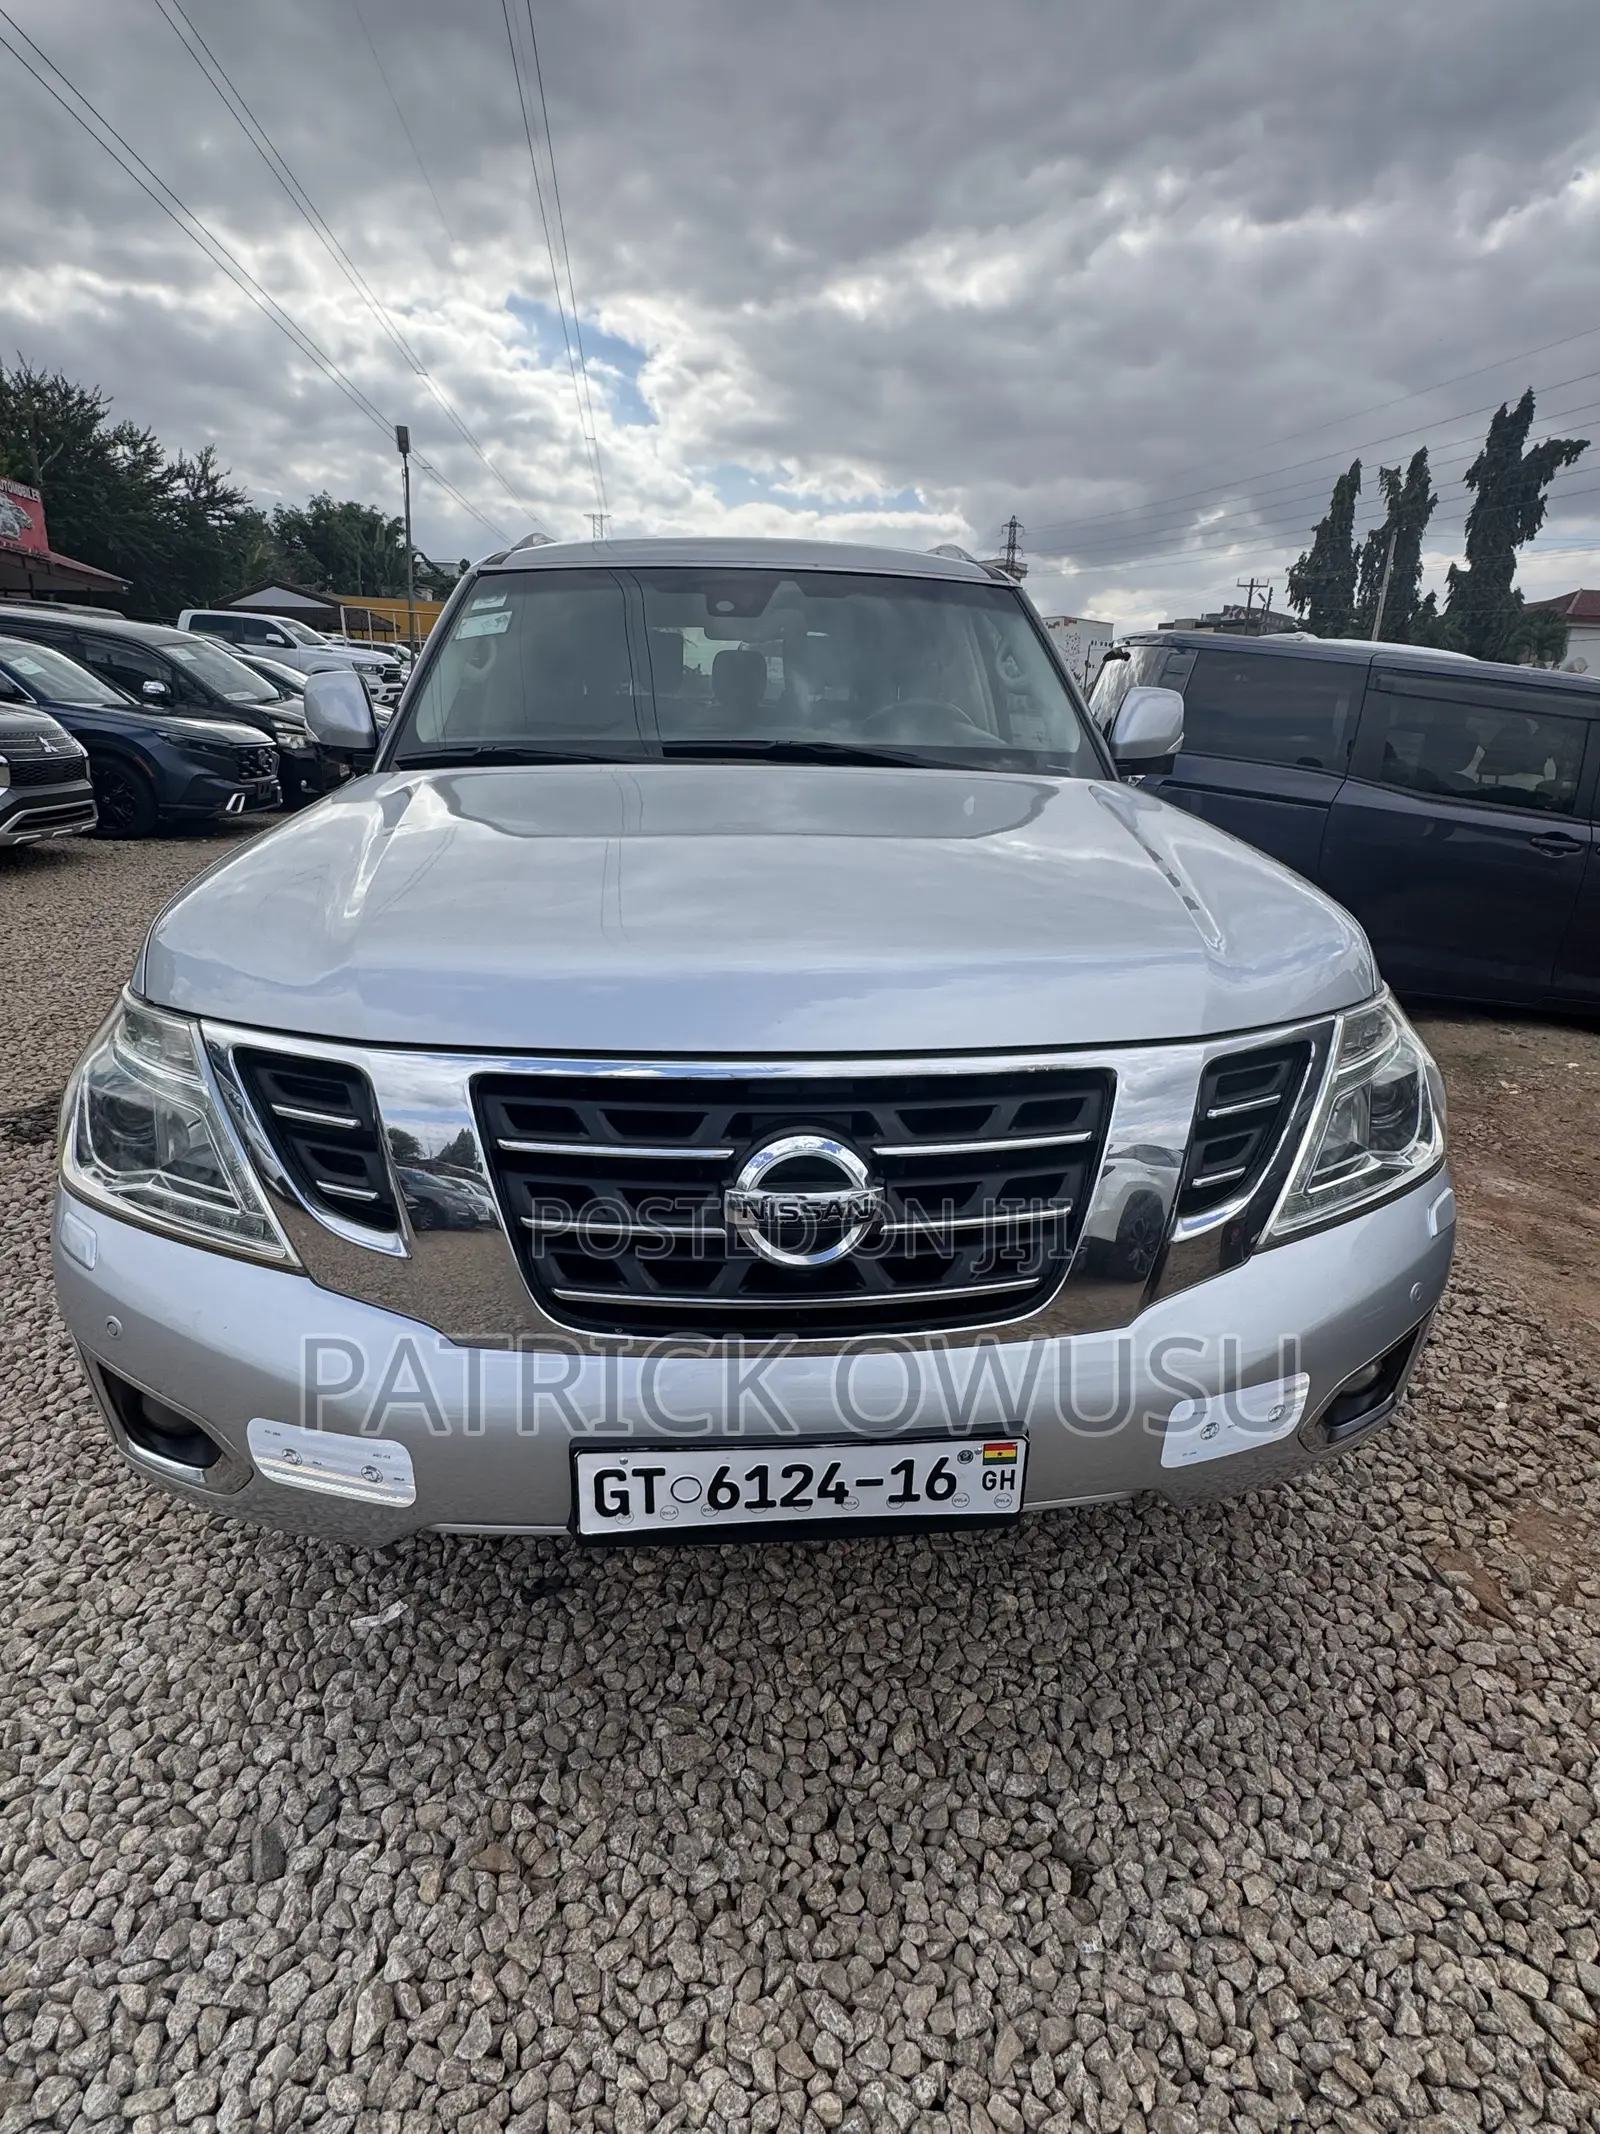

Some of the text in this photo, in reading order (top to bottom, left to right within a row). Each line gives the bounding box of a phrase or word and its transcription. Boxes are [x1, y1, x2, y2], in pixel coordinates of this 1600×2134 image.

[741, 1194, 873, 1223] NISSAN
[594, 1456, 957, 1518] GT 6124-16
[982, 1469, 1016, 1491] GH
